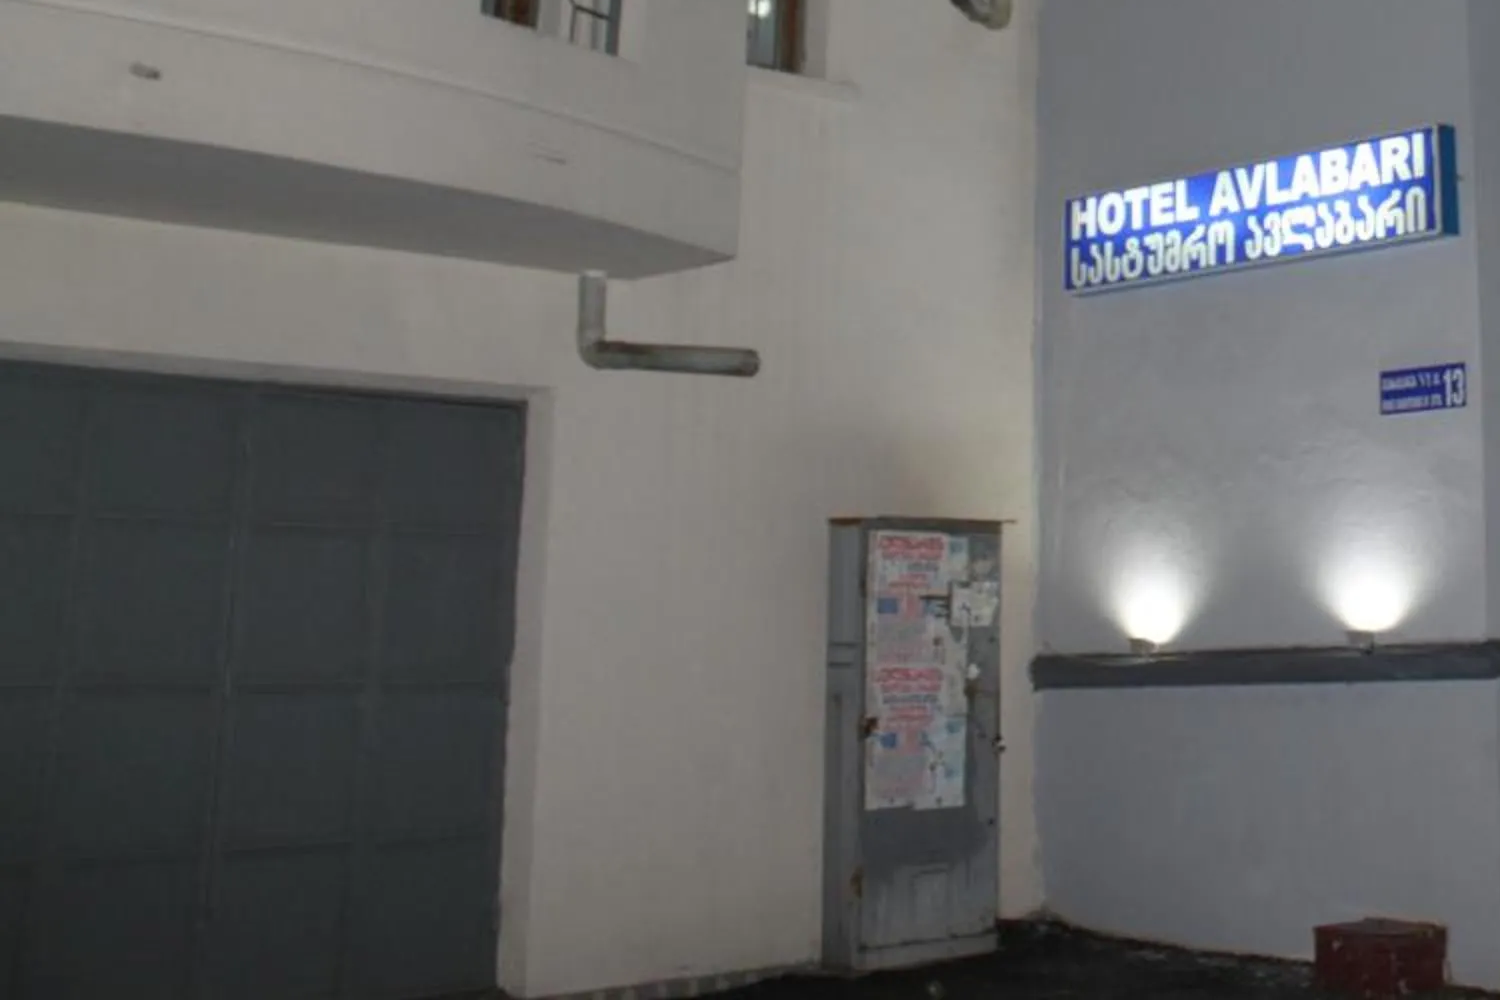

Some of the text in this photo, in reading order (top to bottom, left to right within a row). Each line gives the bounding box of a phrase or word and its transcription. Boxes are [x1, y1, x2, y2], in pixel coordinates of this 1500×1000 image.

[1070, 132, 1425, 241] HOTEL AVLABARI
[1070, 186, 1427, 287] სასტუმრო ავლაბარი
[1443, 367, 1465, 408] 13
